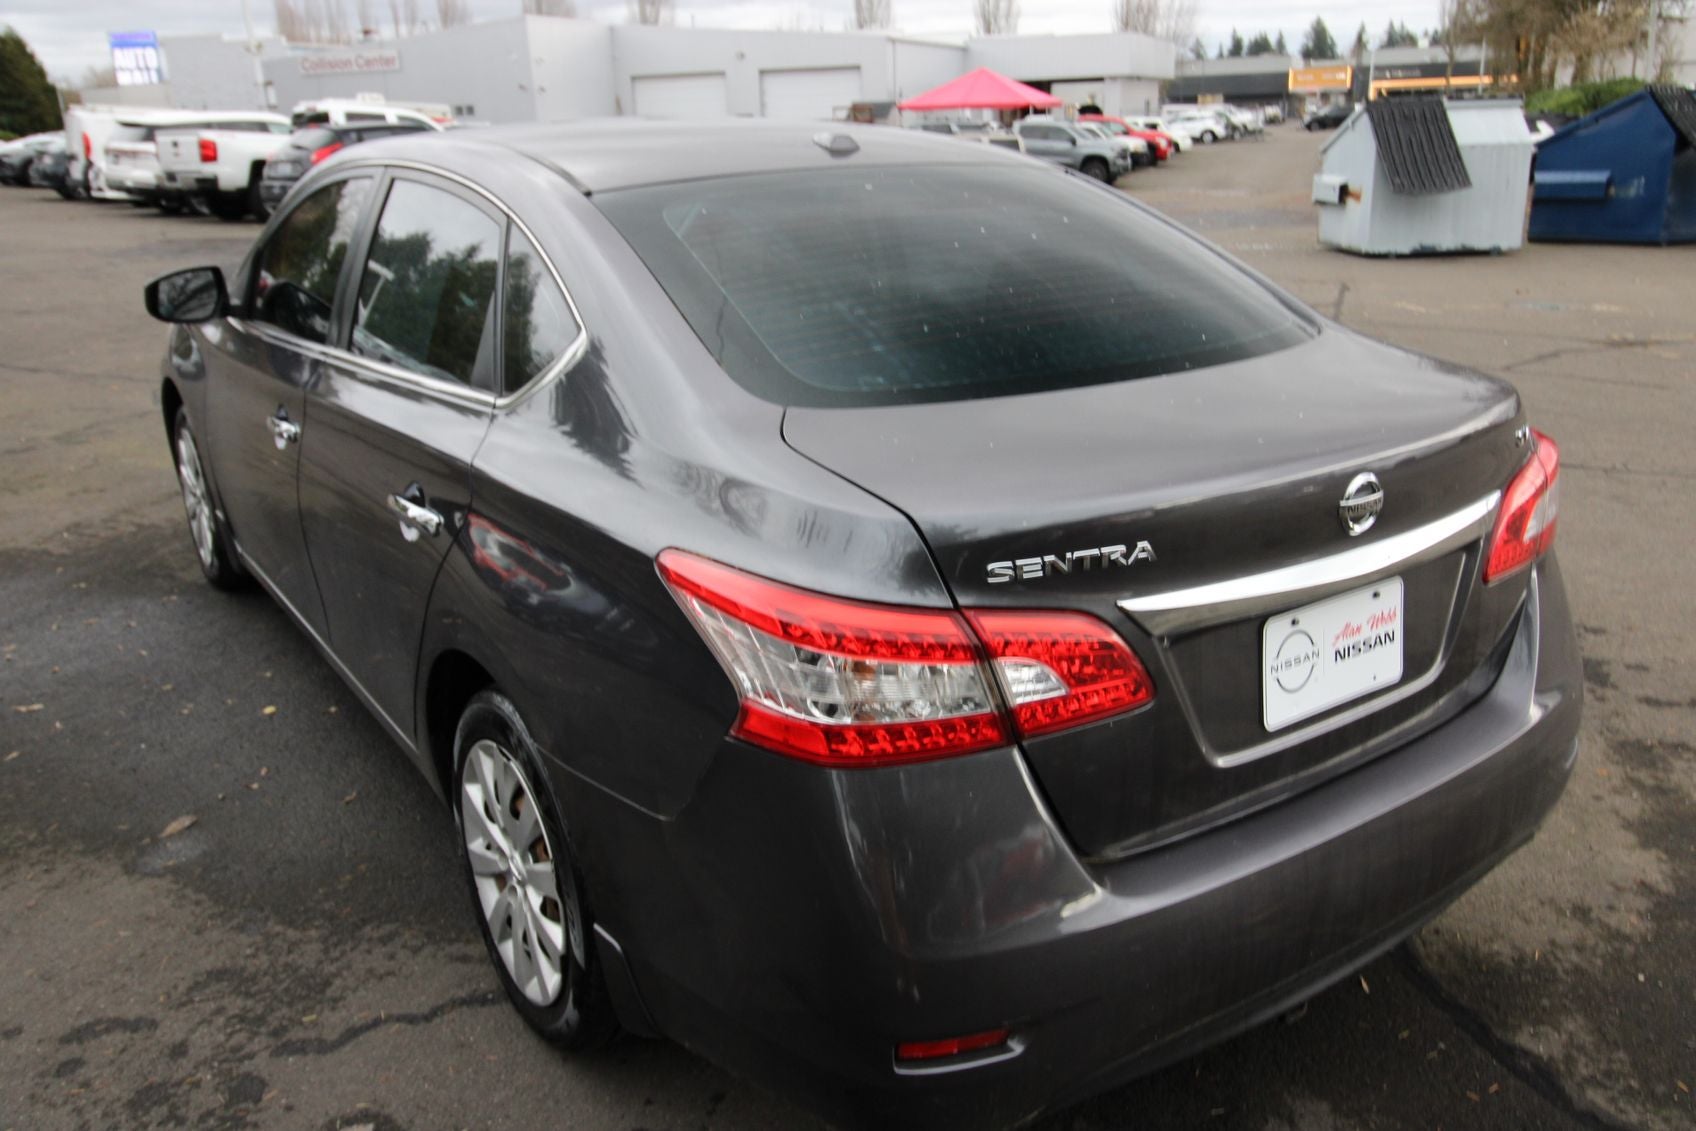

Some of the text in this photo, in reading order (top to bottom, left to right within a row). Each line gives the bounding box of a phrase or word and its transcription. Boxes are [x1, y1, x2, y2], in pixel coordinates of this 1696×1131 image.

[113, 47, 158, 68] AUTO
[302, 54, 396, 72] Collision Center
[986, 540, 1157, 584] SENTRA
[1334, 630, 1395, 663] NISSAN
[1270, 648, 1320, 675] NISSAN
